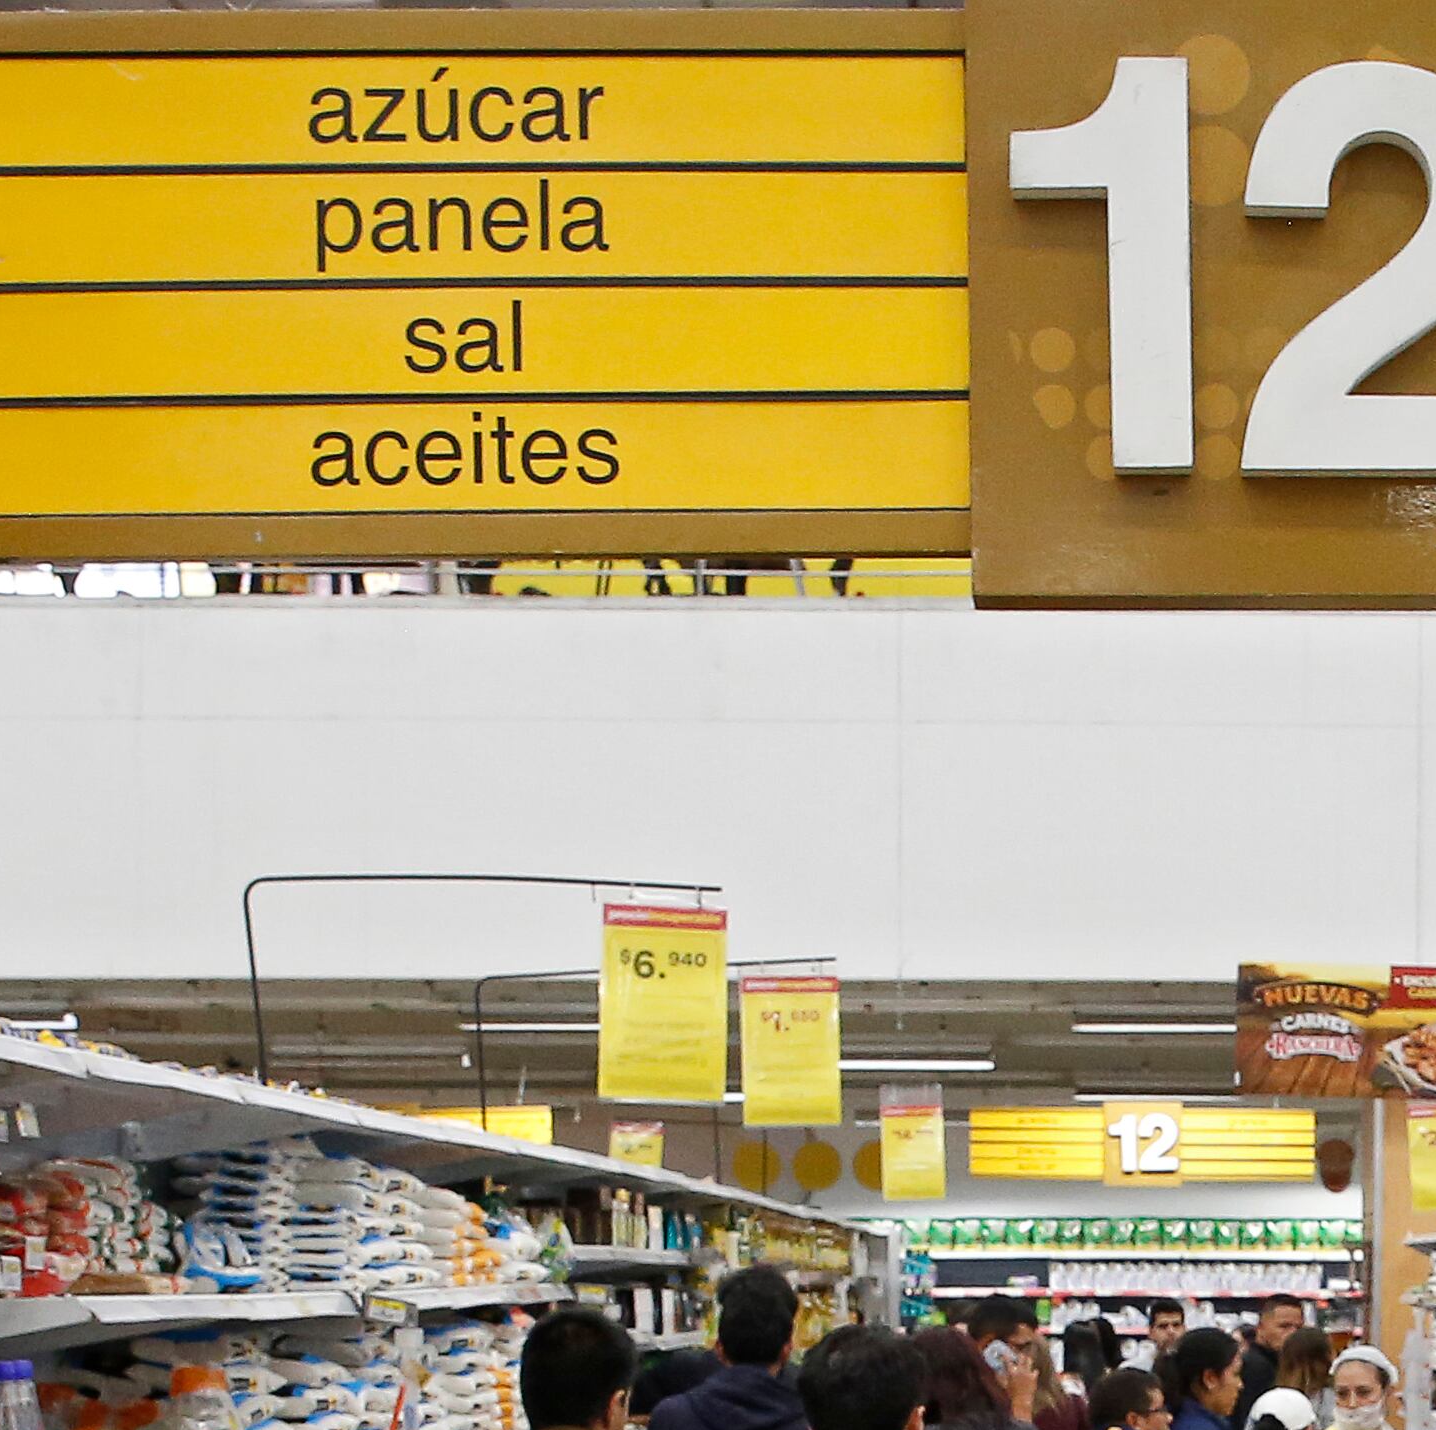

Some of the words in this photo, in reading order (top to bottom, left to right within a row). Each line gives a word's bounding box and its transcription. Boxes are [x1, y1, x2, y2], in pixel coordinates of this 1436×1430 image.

[307, 68, 604, 145] azúcar
[315, 179, 610, 271] panela
[405, 300, 523, 374] sal
[310, 412, 620, 486] aceites
[1265, 984, 1368, 1007] NUEVAS
[1108, 1113, 1179, 1173] 12
